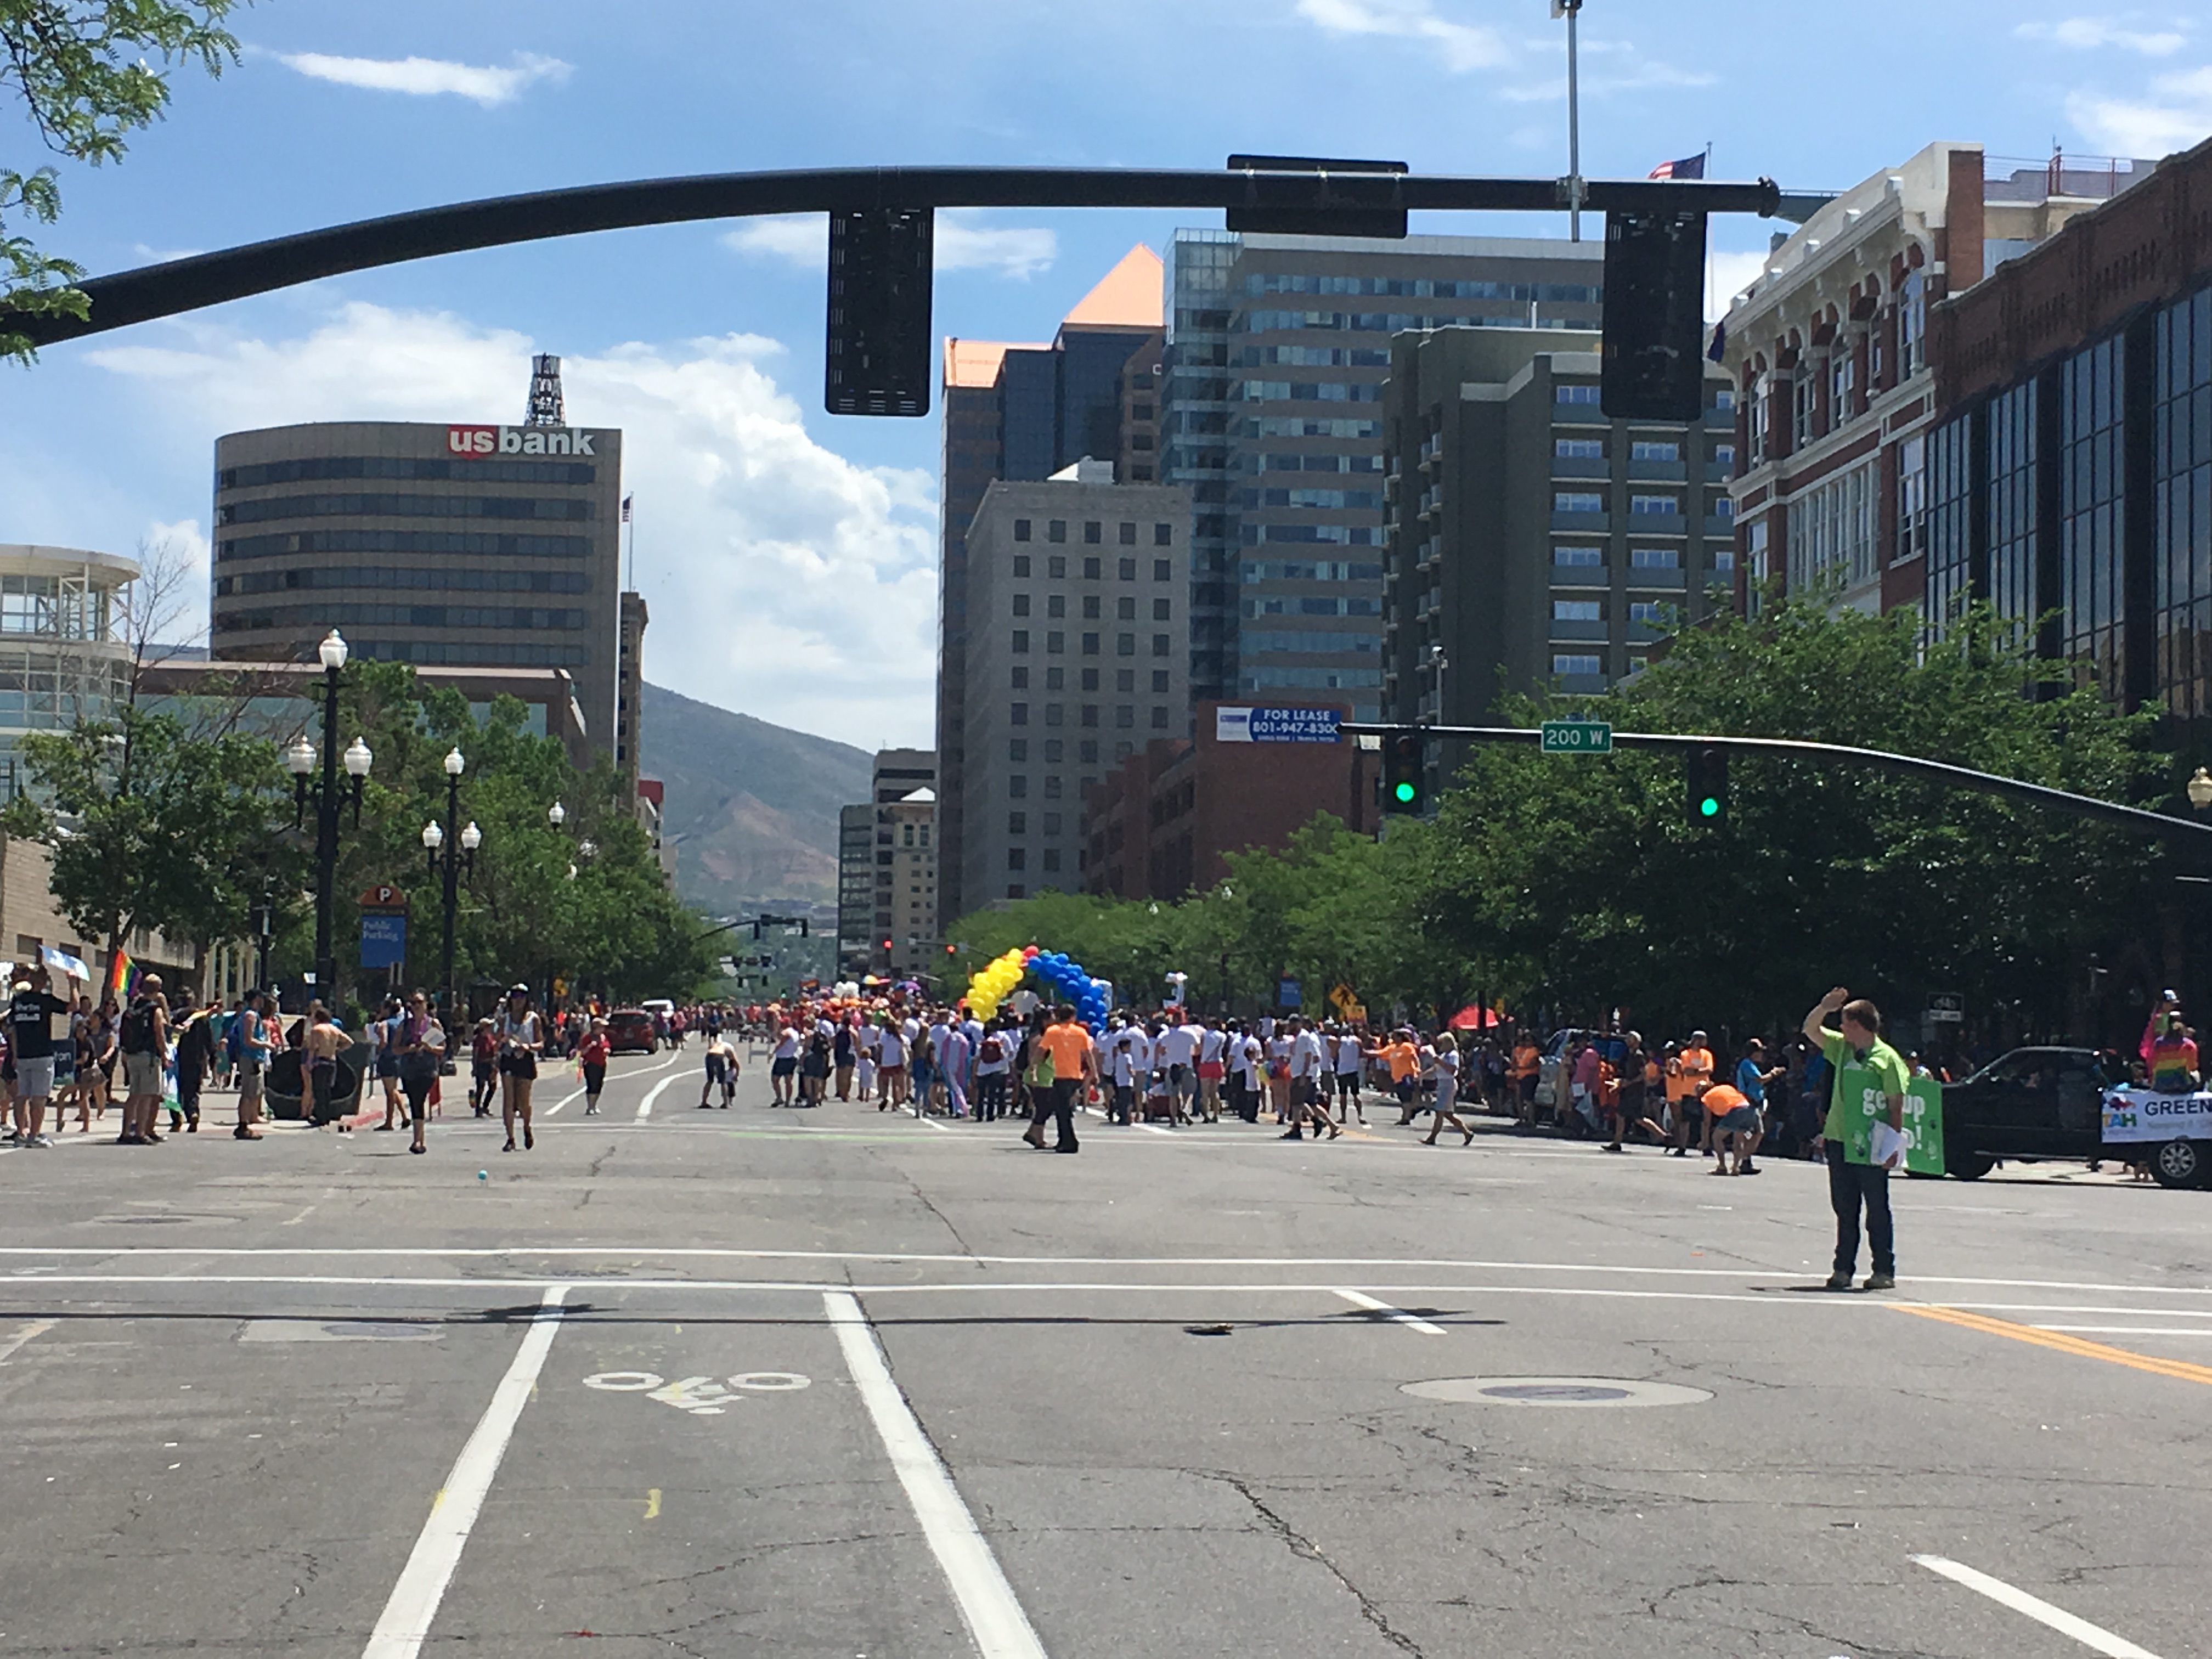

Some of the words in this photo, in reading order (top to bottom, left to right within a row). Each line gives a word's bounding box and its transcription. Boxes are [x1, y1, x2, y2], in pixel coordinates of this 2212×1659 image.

[1263, 709, 1289, 720] FOR
[1294, 710, 1330, 721] LEASE
[1546, 729, 1581, 745] 200
[380, 888, 392, 902] P
[363, 930, 398, 942] Parking
[1863, 1088, 1887, 1116] ge
[1901, 1094, 1926, 1122] up
[2145, 1099, 2212, 1116] GREEN
